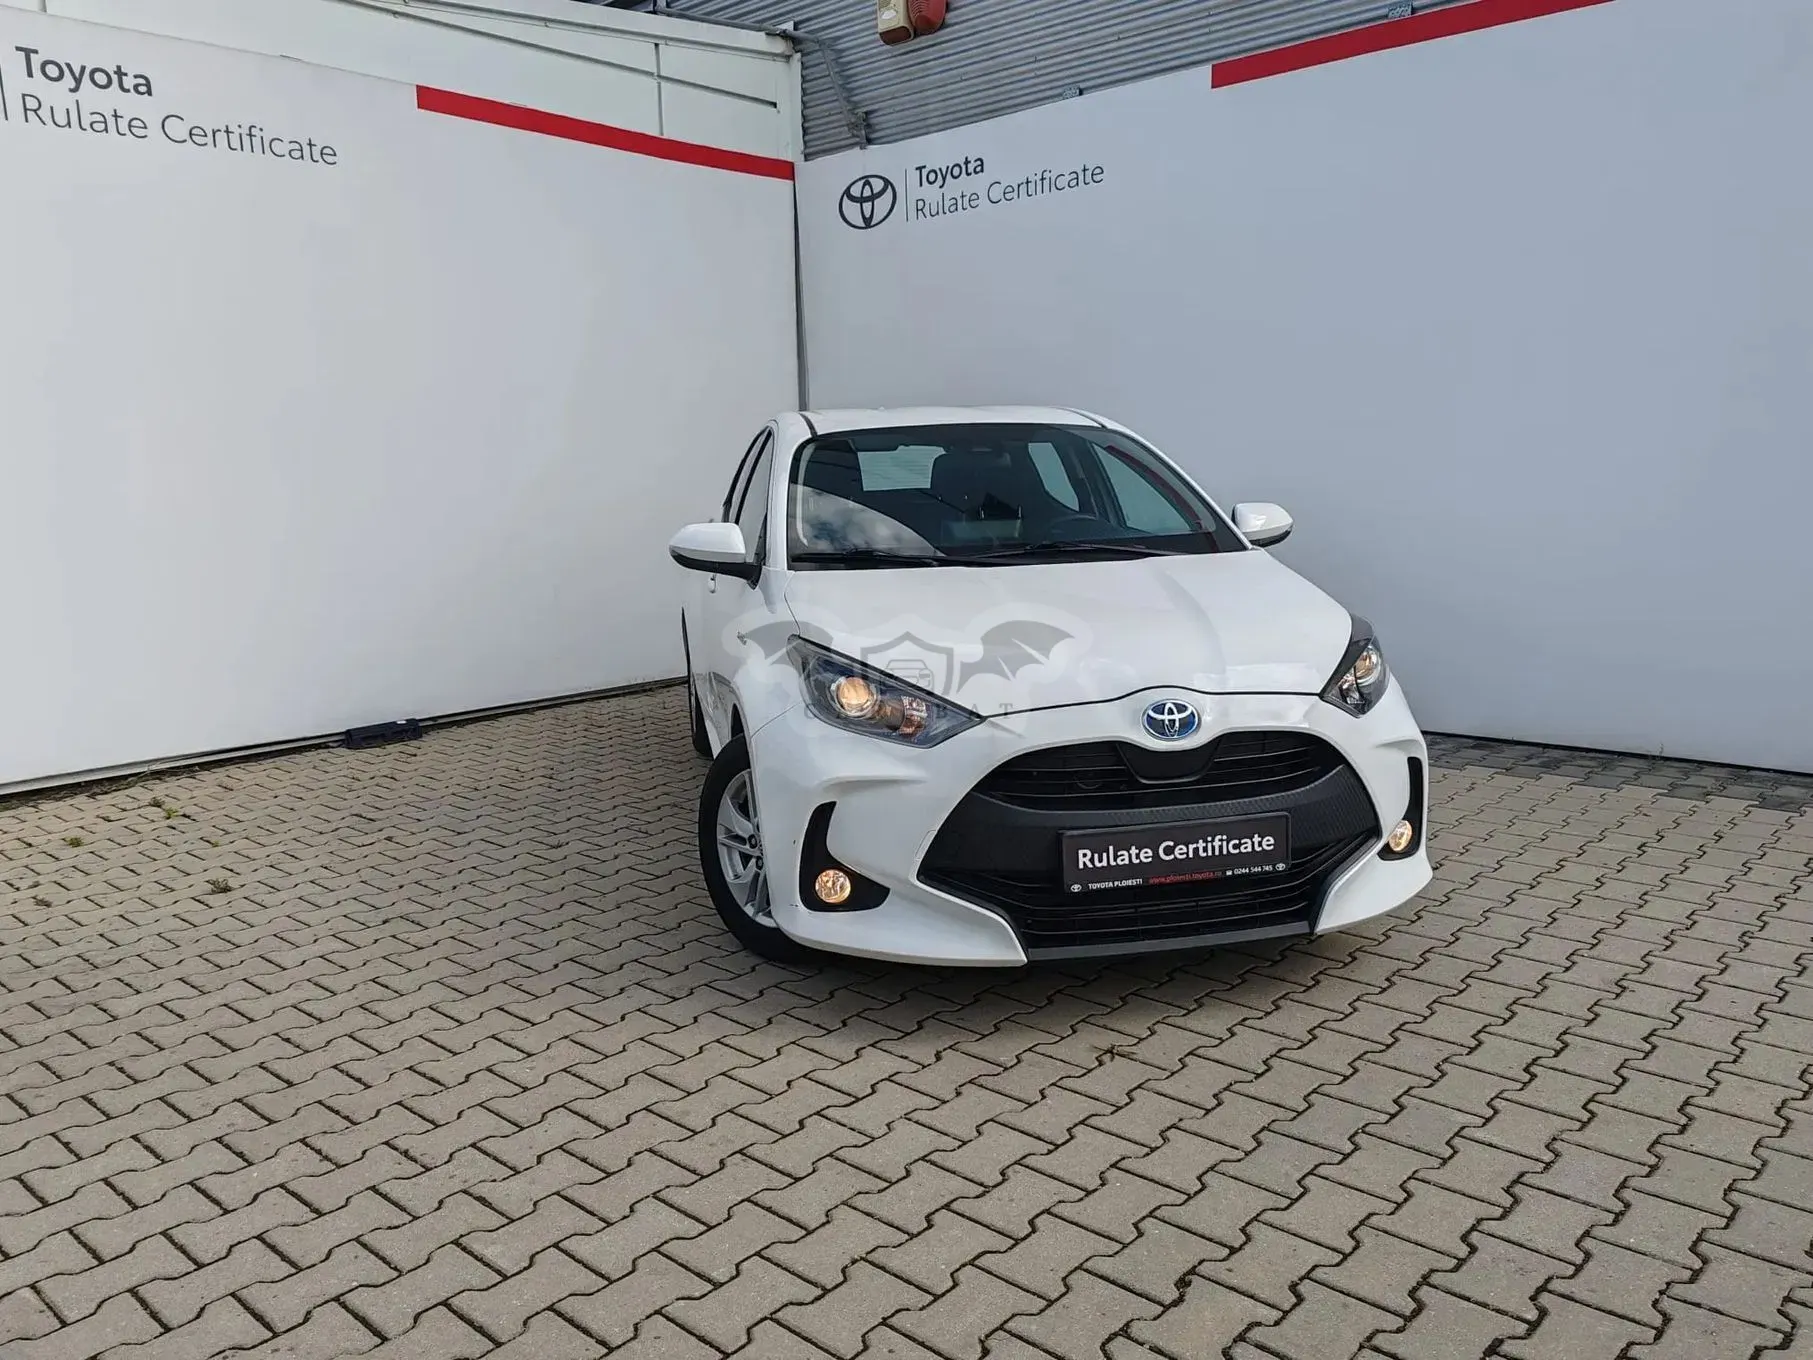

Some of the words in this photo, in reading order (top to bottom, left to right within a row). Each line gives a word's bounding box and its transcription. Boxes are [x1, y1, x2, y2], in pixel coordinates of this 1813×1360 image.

[15, 46, 153, 97] Toyota
[21, 93, 149, 139] Rulate
[160, 114, 338, 165] Certificate
[915, 155, 985, 188] Toyota
[915, 191, 980, 220] Rulate
[987, 163, 1105, 205] Certificate
[1077, 845, 1153, 870] Rulate
[1158, 833, 1275, 861] Certificate
[1088, 881, 1114, 890] TOYOTA
[1114, 878, 1143, 887] PLOIESTI
[1233, 867, 1250, 875] 0244
[1250, 865, 1262, 873] 544
